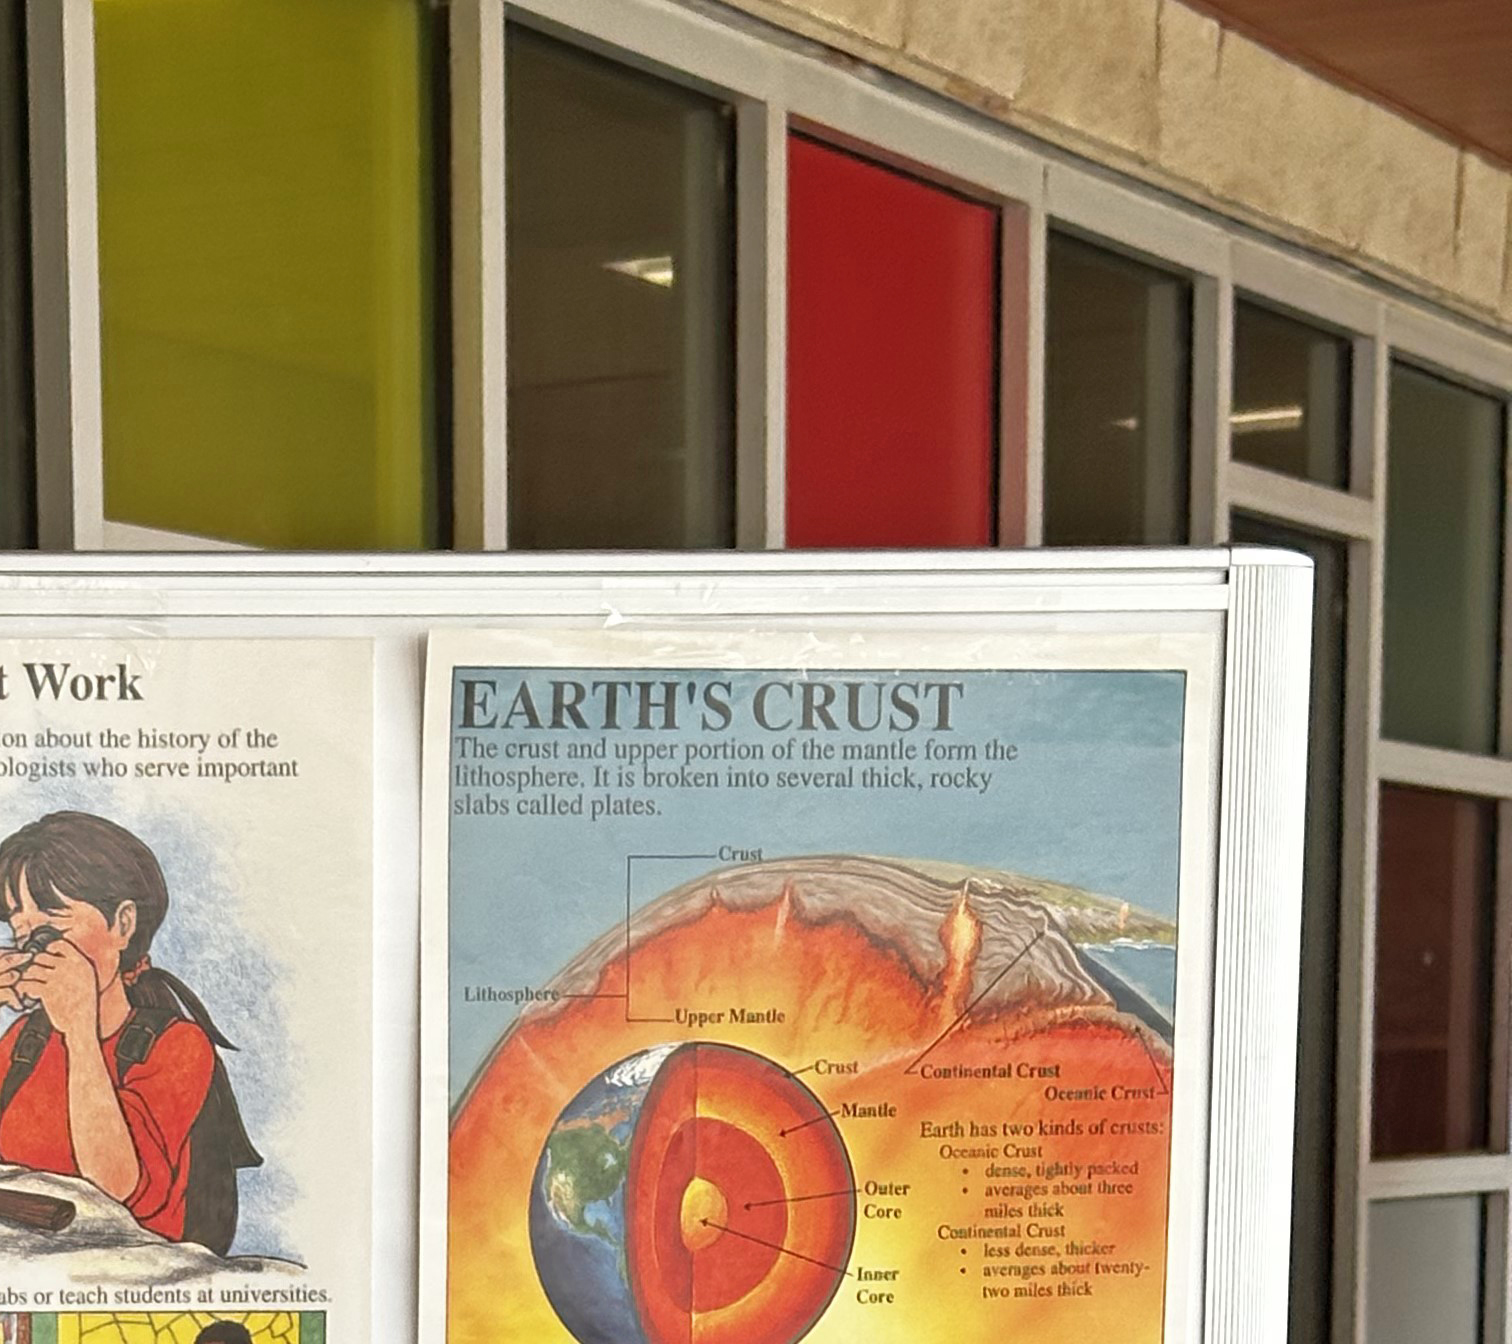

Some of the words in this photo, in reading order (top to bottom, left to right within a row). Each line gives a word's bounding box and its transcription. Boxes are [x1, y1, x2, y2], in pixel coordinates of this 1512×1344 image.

[23, 664, 144, 701] Work
[458, 680, 733, 731] EARTH'S
[752, 682, 964, 731] CRUST
[35, 729, 93, 748] about
[99, 729, 131, 748] the
[137, 729, 210, 754] history
[218, 728, 241, 748] of
[246, 729, 278, 748] the
[455, 736, 498, 758] The
[505, 740, 559, 759] crust
[567, 738, 606, 759] and
[614, 742, 678, 765] upper
[685, 739, 764, 766] portion
[772, 739, 795, 760] of
[802, 739, 835, 760] the
[842, 739, 916, 760] mantle
[924, 739, 977, 760] form
[985, 739, 1018, 761] the
[83, 759, 127, 776] who
[134, 763, 189, 777] serve
[196, 759, 299, 782] important
[454, 767, 585, 792] lithosphere.
[593, 767, 610, 787] It
[618, 766, 635, 787] is
[643, 767, 719, 787] broken
[727, 766, 769, 788] into
[776, 767, 853, 788] several
[862, 767, 923, 791] thick,
[931, 768, 992, 794] rocky
[454, 793, 509, 815] slabs
[517, 794, 583, 815] called
[591, 794, 662, 821] plates.
[719, 846, 762, 861] Crust
[464, 986, 560, 1004] Lithosphere
[675, 1009, 724, 1027] Upper
[729, 1008, 785, 1023] Mantle
[815, 1060, 858, 1075] Crust
[921, 1064, 1011, 1079] Continental
[1017, 1064, 1060, 1078] Crust
[1044, 1086, 1107, 1101] Oceanic
[1111, 1085, 1155, 1099] Crust
[840, 1104, 897, 1118] Mantle
[920, 1121, 966, 1138] Earth
[969, 1121, 997, 1138] has
[1002, 1123, 1034, 1137] two
[1039, 1121, 1083, 1136] kinds
[1089, 1120, 1107, 1135] of
[865, 1181, 910, 1196] Outer
[864, 1204, 902, 1219] Core
[938, 1225, 1021, 1240] Continental
[1027, 1224, 1066, 1238] Crust
[857, 1267, 899, 1282] Inner
[34, 1291, 53, 1304] or
[60, 1286, 108, 1304] teach
[114, 1286, 191, 1304] students
[197, 1288, 215, 1303] at
[221, 1284, 332, 1303] universities.
[857, 1289, 894, 1304] Core
